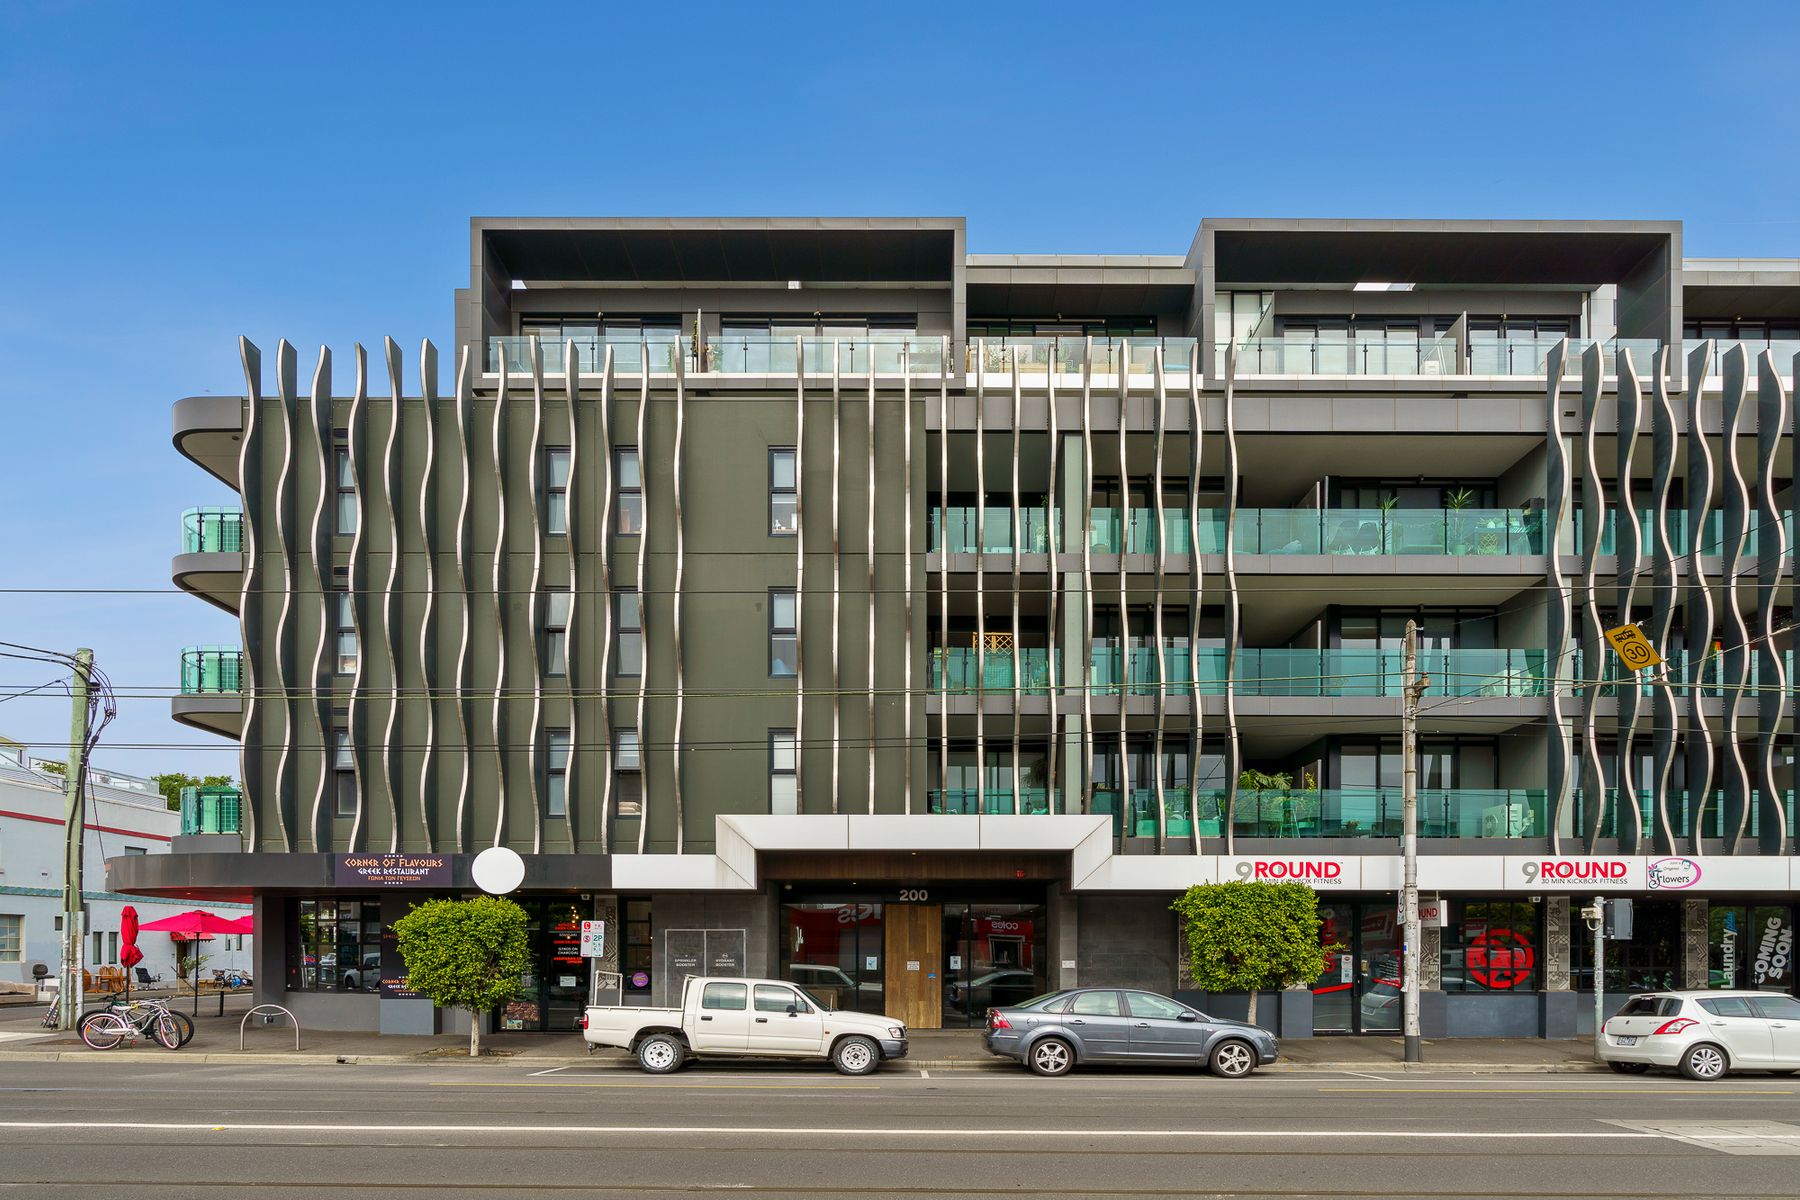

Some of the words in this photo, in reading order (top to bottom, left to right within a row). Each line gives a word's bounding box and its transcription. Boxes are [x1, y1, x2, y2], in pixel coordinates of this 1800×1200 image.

[1626, 645, 1647, 660] 30
[345, 858, 379, 868] CORNER
[382, 858, 395, 868] OF
[358, 867, 381, 875] GREEK
[383, 867, 429, 875] RESTAURANT
[1235, 861, 1341, 884] 9ROUND
[1521, 861, 1627, 884] 9ROUND
[1648, 871, 1690, 889] Flowers
[899, 889, 928, 901] 200
[1418, 906, 1438, 918] UND
[593, 934, 603, 942] 2P
[1754, 917, 1782, 984] COMING
[1720, 929, 1738, 989] Laundry
